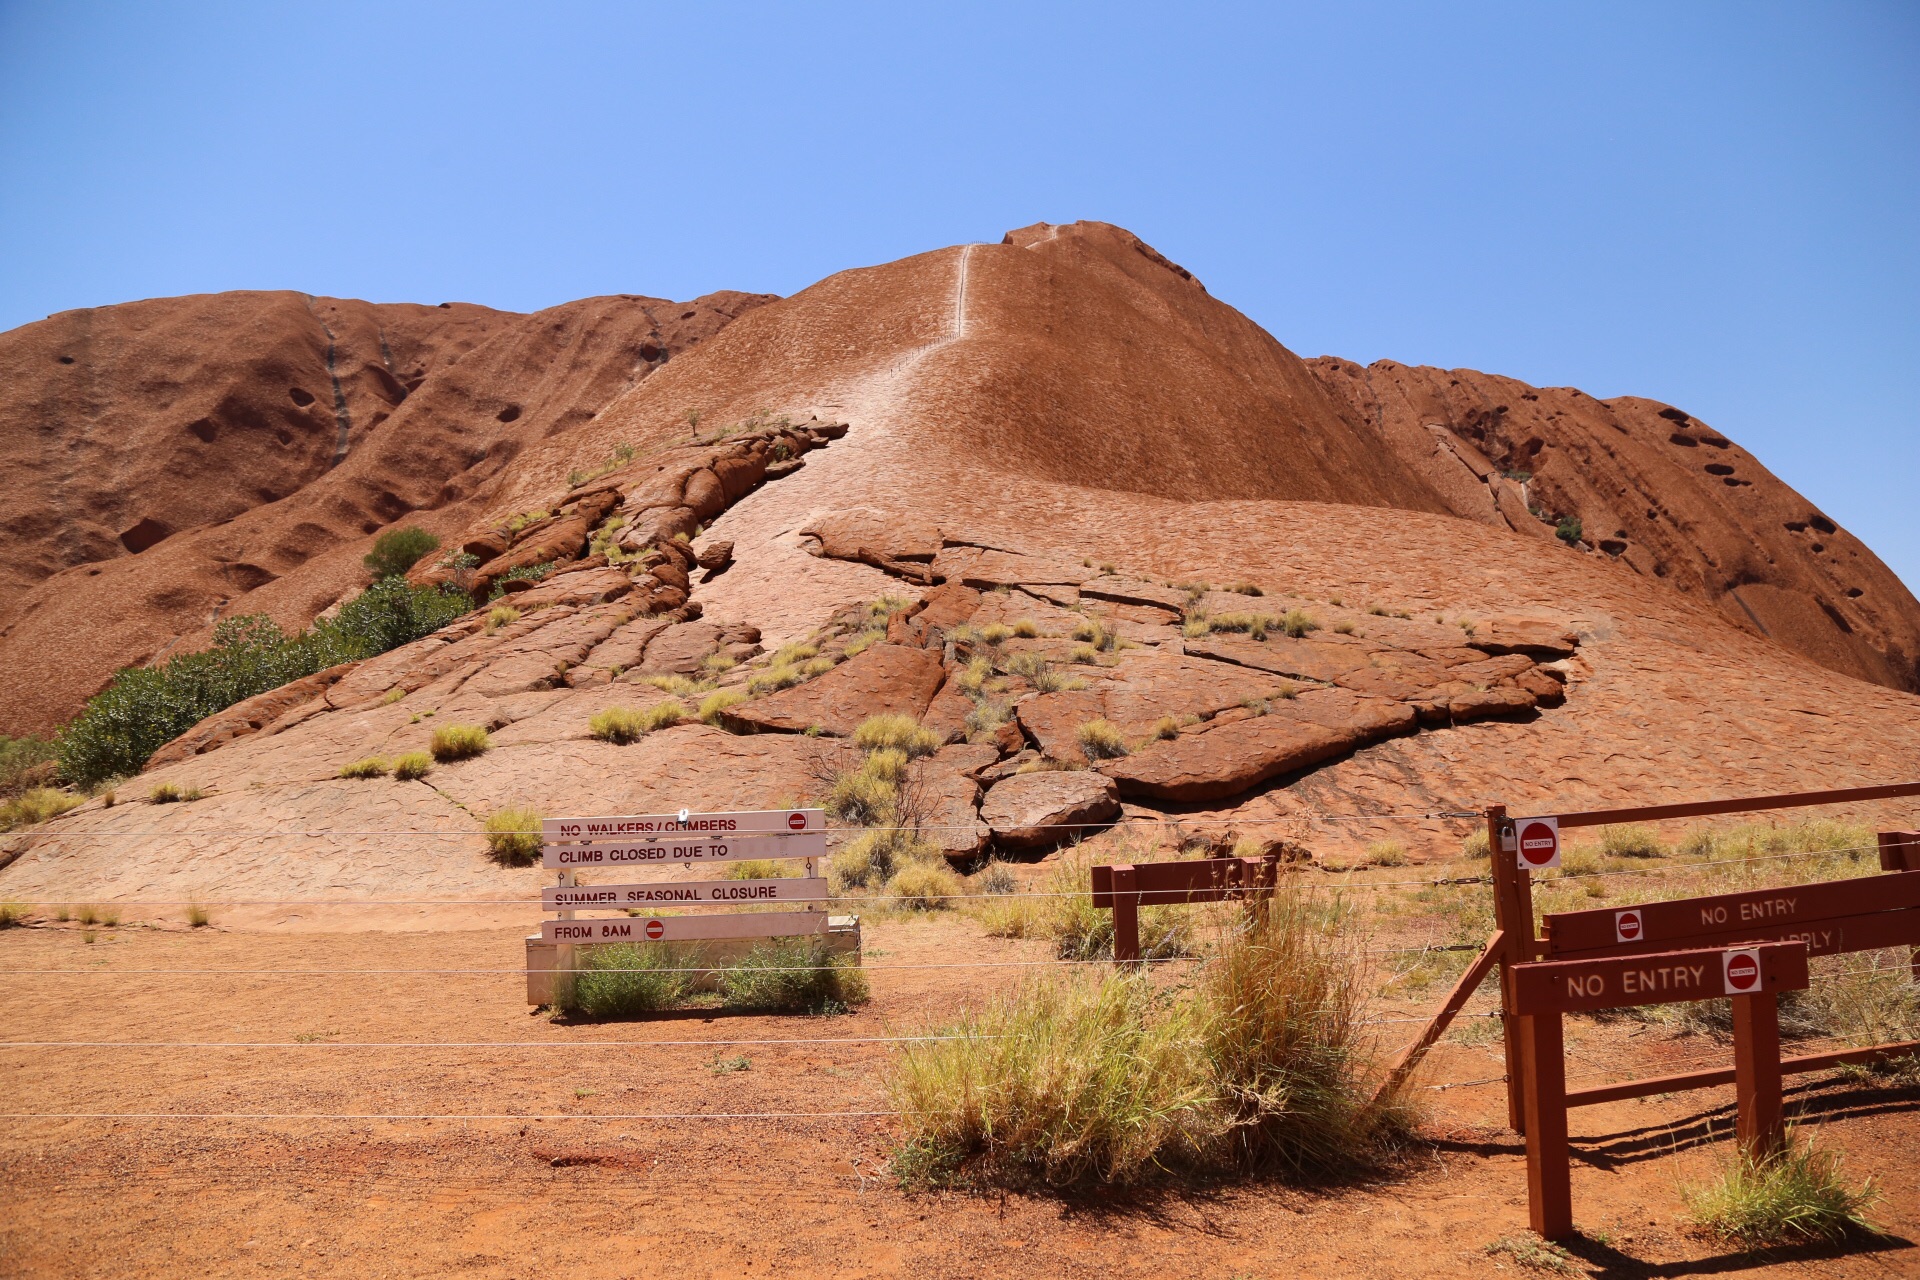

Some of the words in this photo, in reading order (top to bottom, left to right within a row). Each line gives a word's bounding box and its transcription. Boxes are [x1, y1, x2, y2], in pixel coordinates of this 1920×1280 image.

[560, 825, 581, 836] NO
[559, 851, 603, 863] CLIMB
[610, 847, 666, 861] CLOSED
[673, 845, 703, 859] DUE
[709, 844, 728, 857] TO
[555, 892, 617, 905] SUMMER
[627, 889, 702, 903] SEASONAL
[1701, 906, 1728, 925] NO
[1740, 898, 1798, 921] ENTRY
[602, 925, 631, 937] 8AM
[1568, 974, 1604, 997] NO
[1623, 965, 1704, 993] ENTRY
